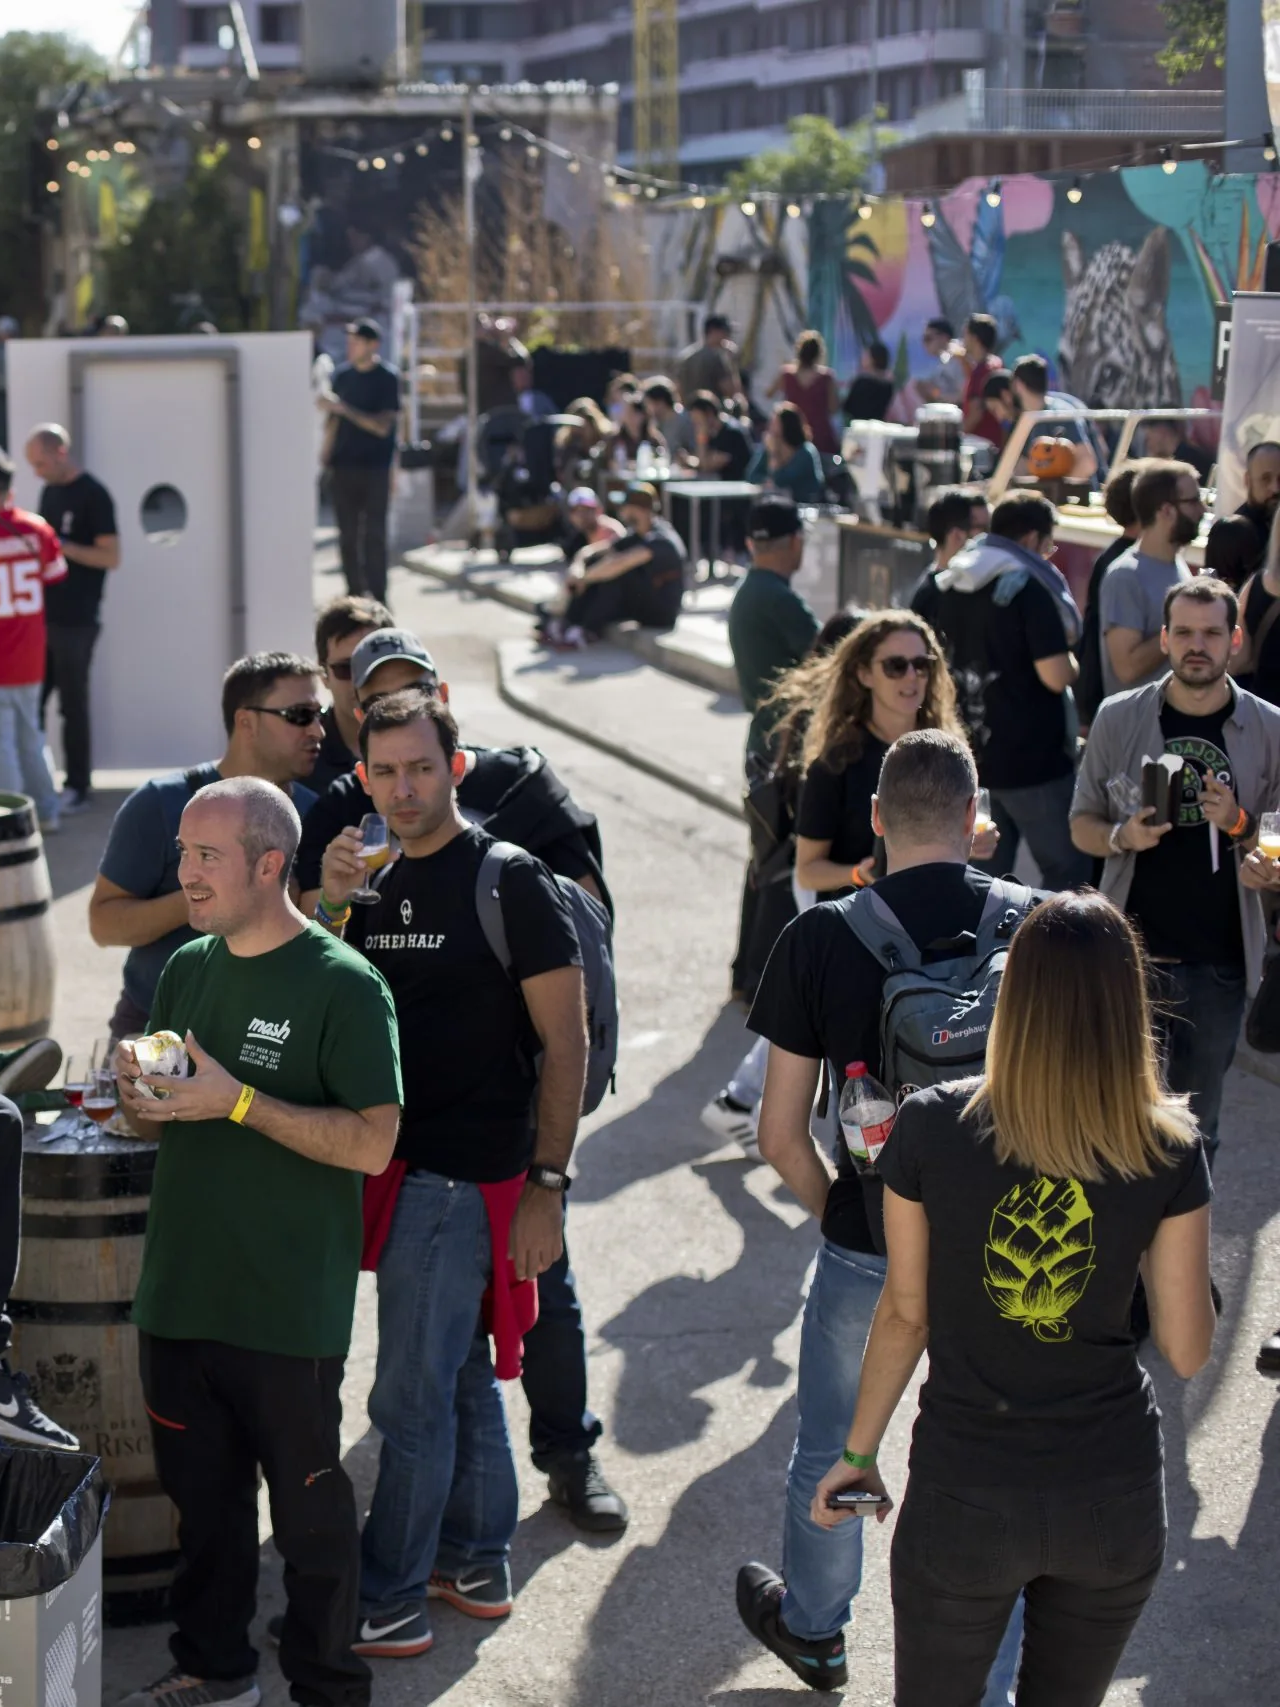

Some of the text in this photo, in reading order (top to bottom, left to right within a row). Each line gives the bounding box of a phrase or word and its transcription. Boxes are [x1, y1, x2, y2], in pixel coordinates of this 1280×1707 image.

[365, 933, 445, 950] OTHER HALF
[247, 1017, 290, 1040] mash
[948, 1024, 987, 1039] berghaus
[242, 1043, 281, 1058] CRAFT BEER FEST
[239, 1055, 264, 1066] BARCELONA
